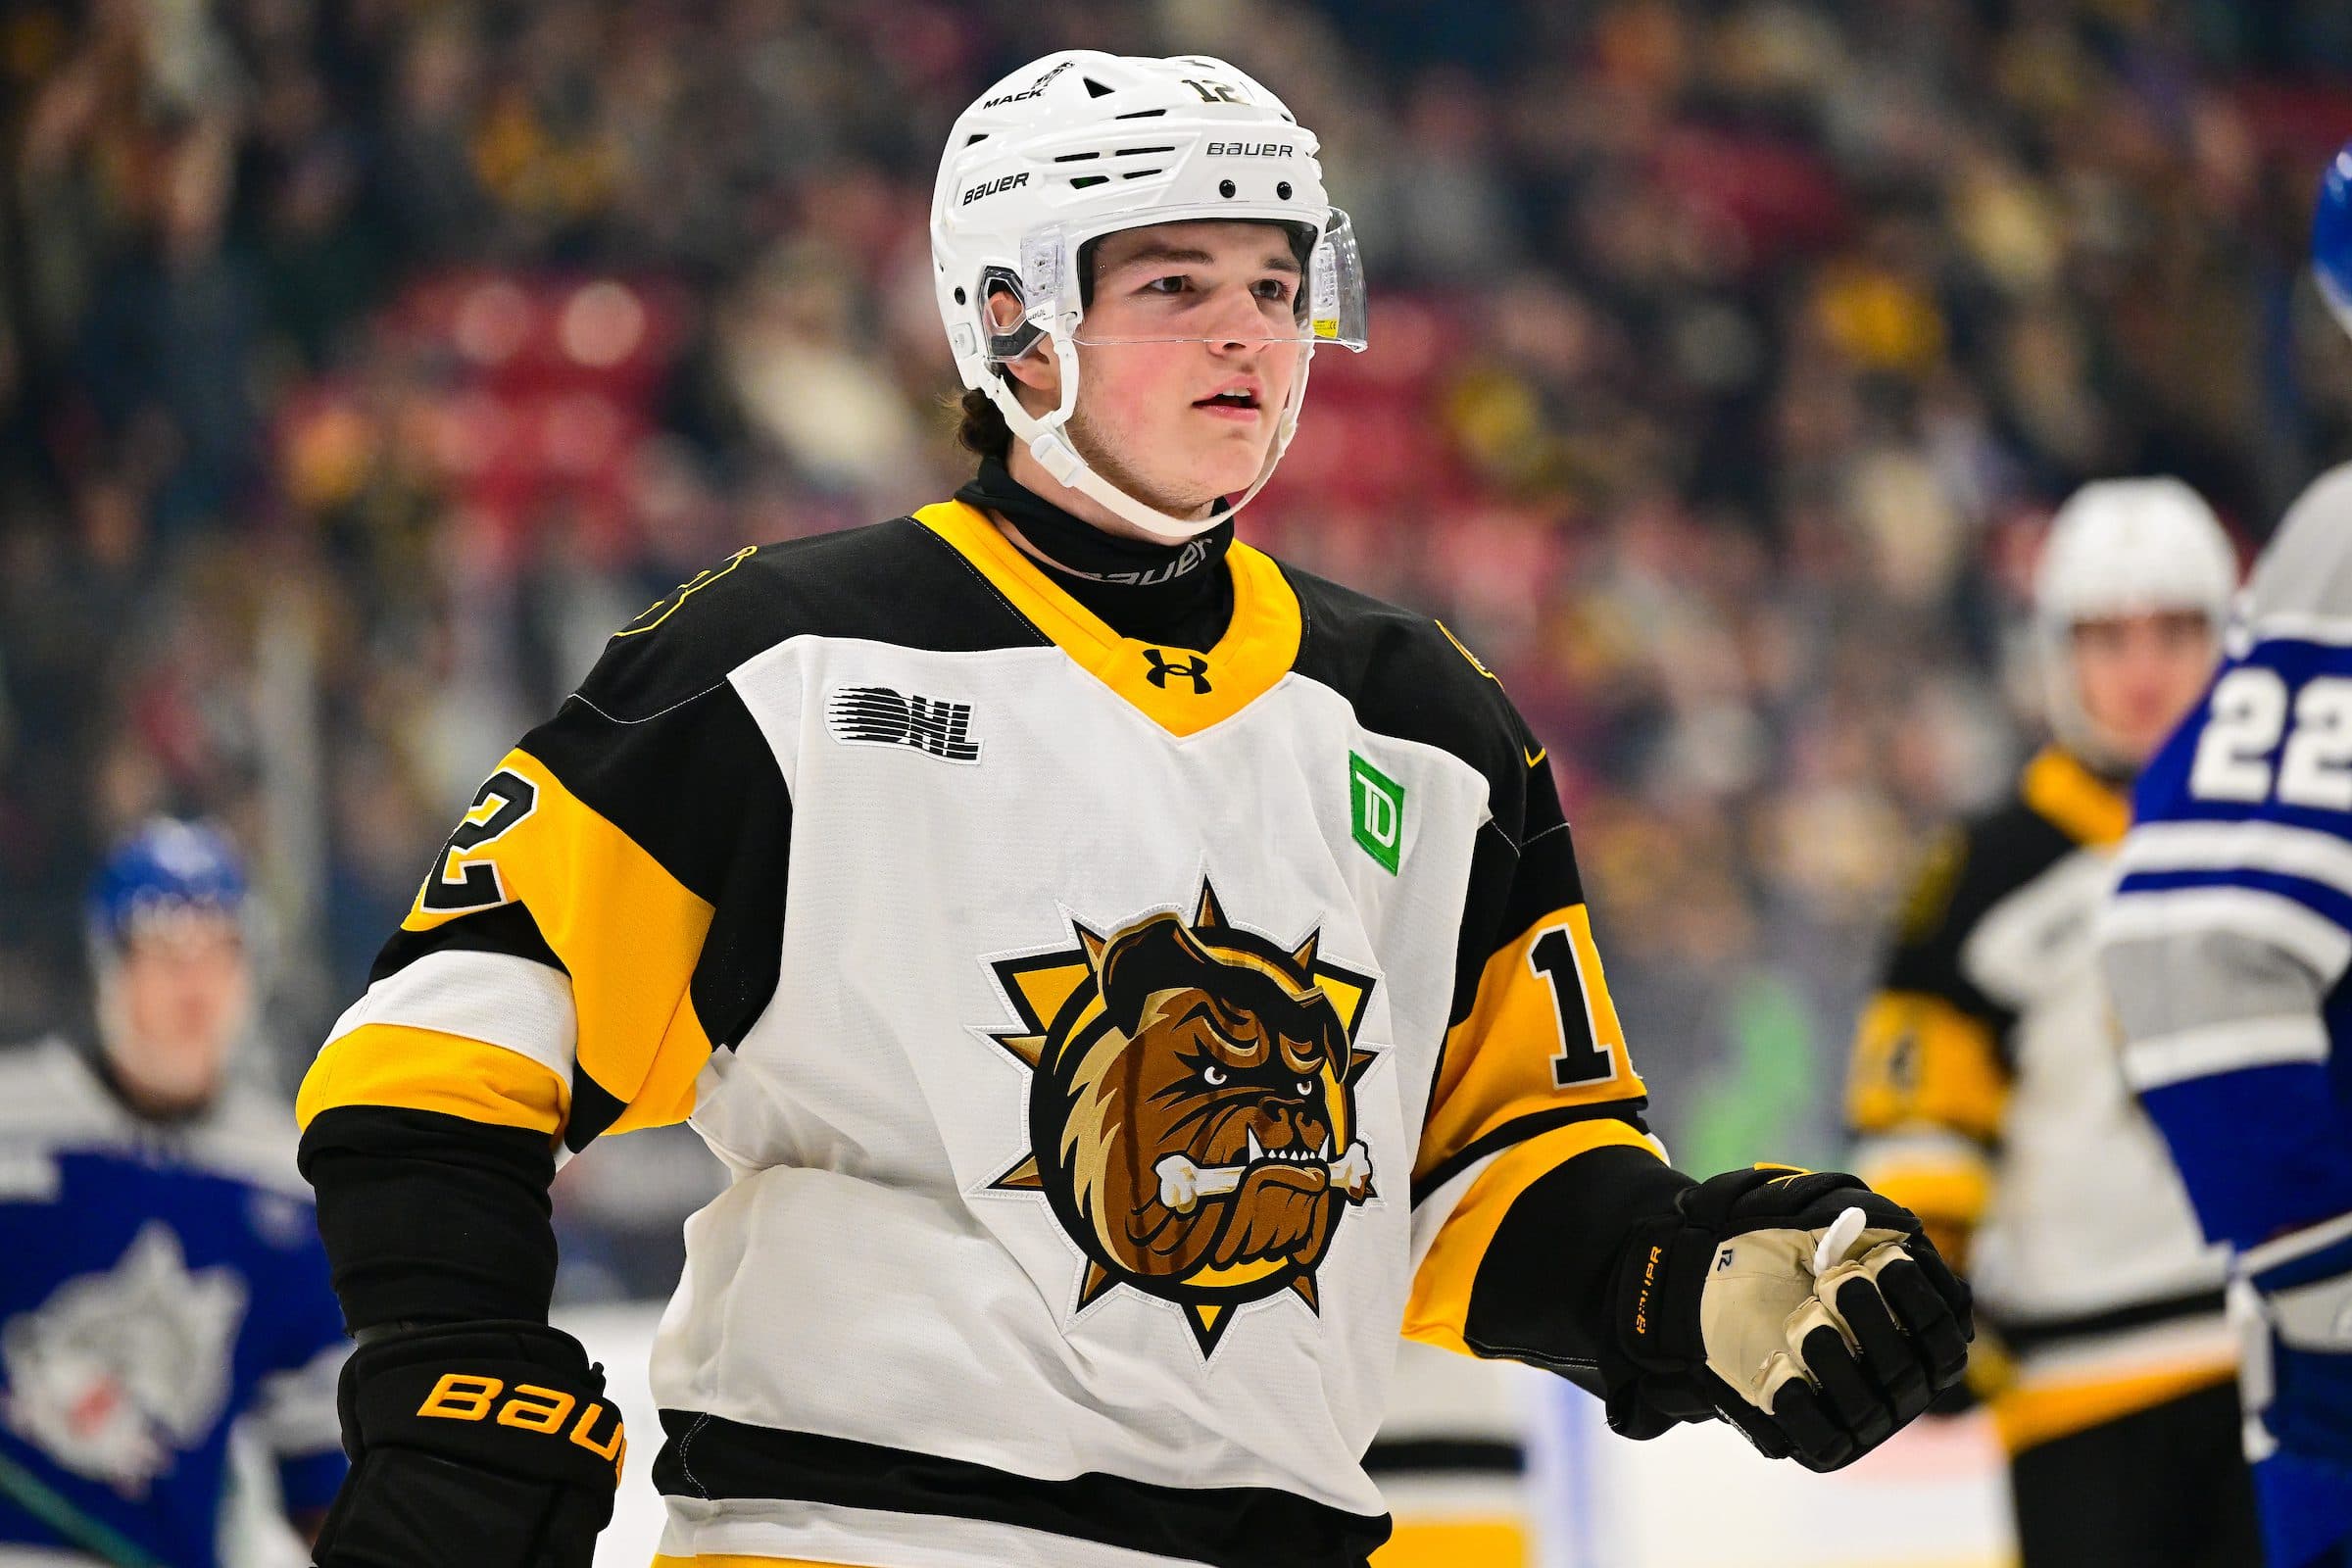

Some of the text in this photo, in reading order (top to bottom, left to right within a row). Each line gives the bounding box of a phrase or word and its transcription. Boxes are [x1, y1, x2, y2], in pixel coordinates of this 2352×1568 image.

[983, 88, 1045, 110] MACK
[1082, 537, 1213, 586] AUER
[2187, 666, 2352, 812] 22
[1355, 769, 1397, 849] TD
